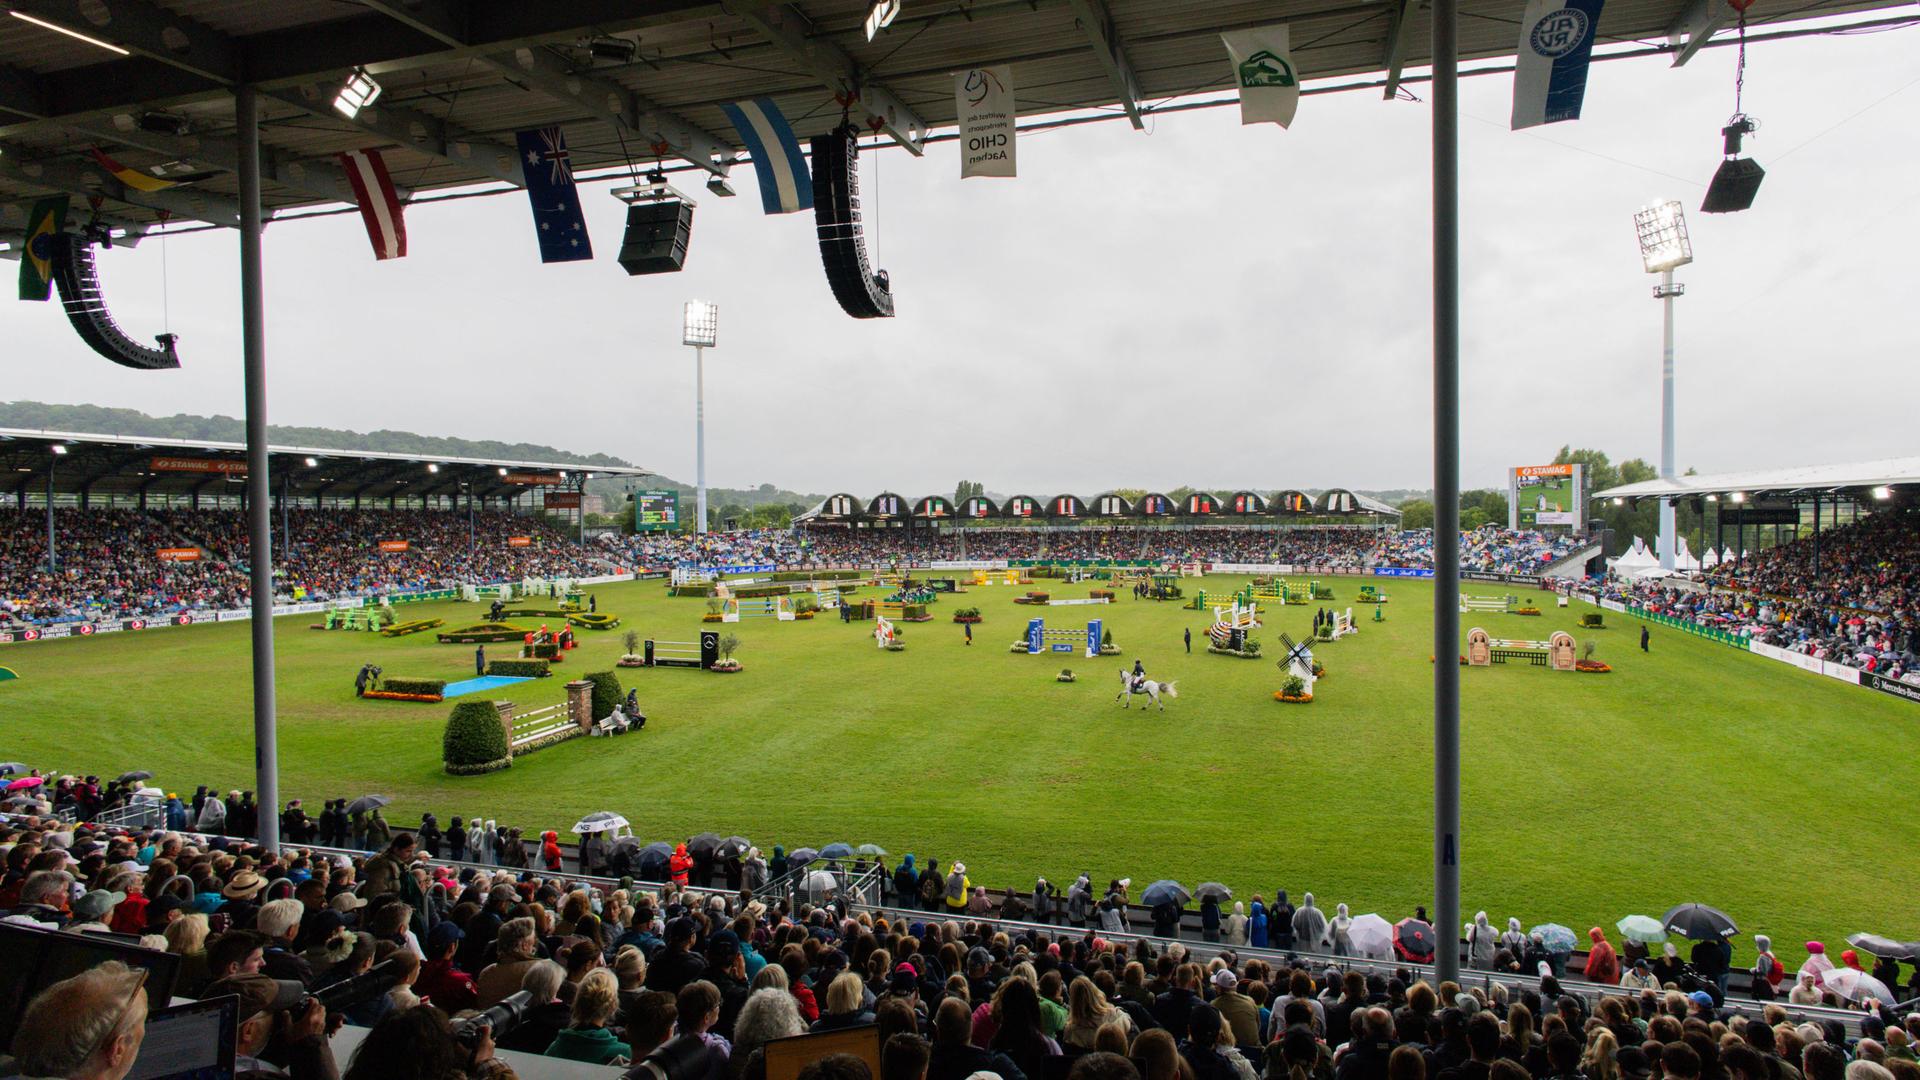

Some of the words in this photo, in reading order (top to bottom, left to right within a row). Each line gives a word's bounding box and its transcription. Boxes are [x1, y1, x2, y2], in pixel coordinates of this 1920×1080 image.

[171, 460, 208, 469] STAWAG
[1533, 466, 1566, 475] STAWAG
[221, 611, 246, 620] Allianz
[1881, 680, 1920, 700] Mercedes-Benz
